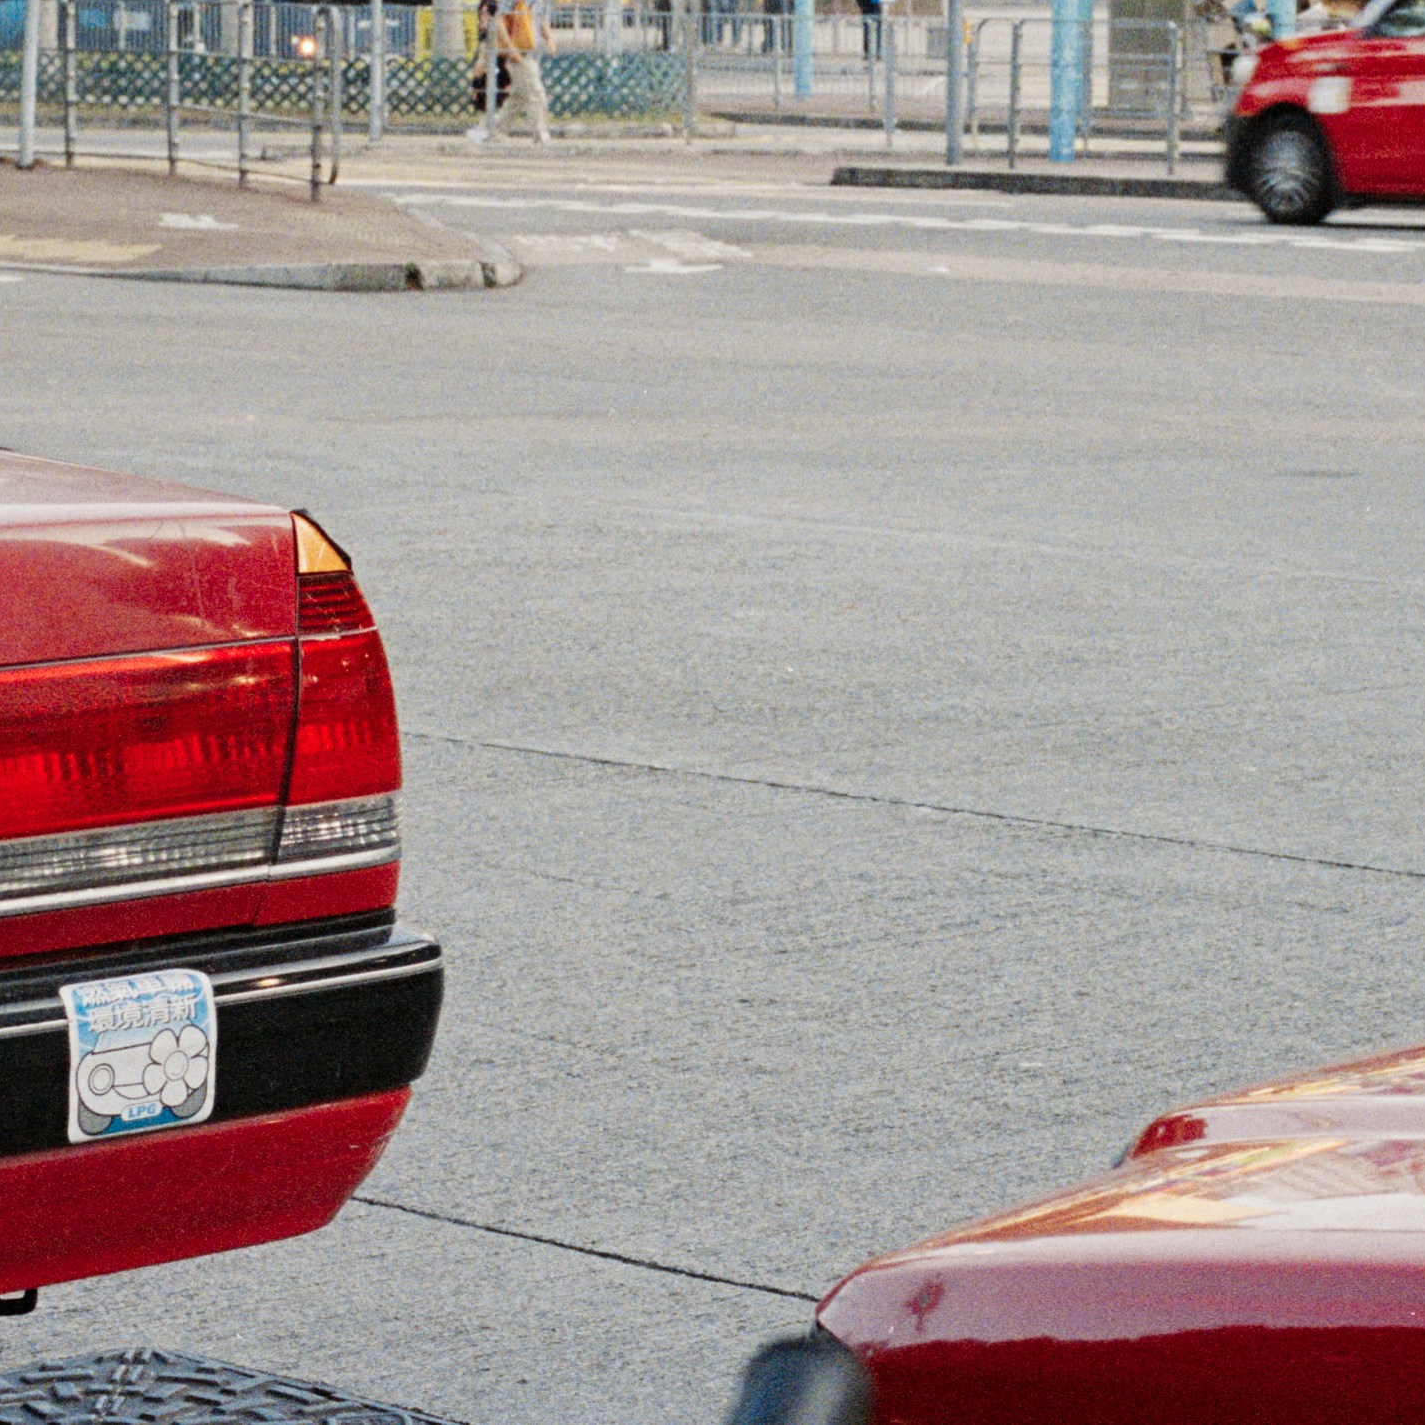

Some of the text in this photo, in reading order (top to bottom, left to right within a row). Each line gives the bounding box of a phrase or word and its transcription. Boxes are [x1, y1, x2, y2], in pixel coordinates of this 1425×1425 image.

[88, 993, 198, 1033] 環境清新
[128, 1103, 157, 1119] LPG
